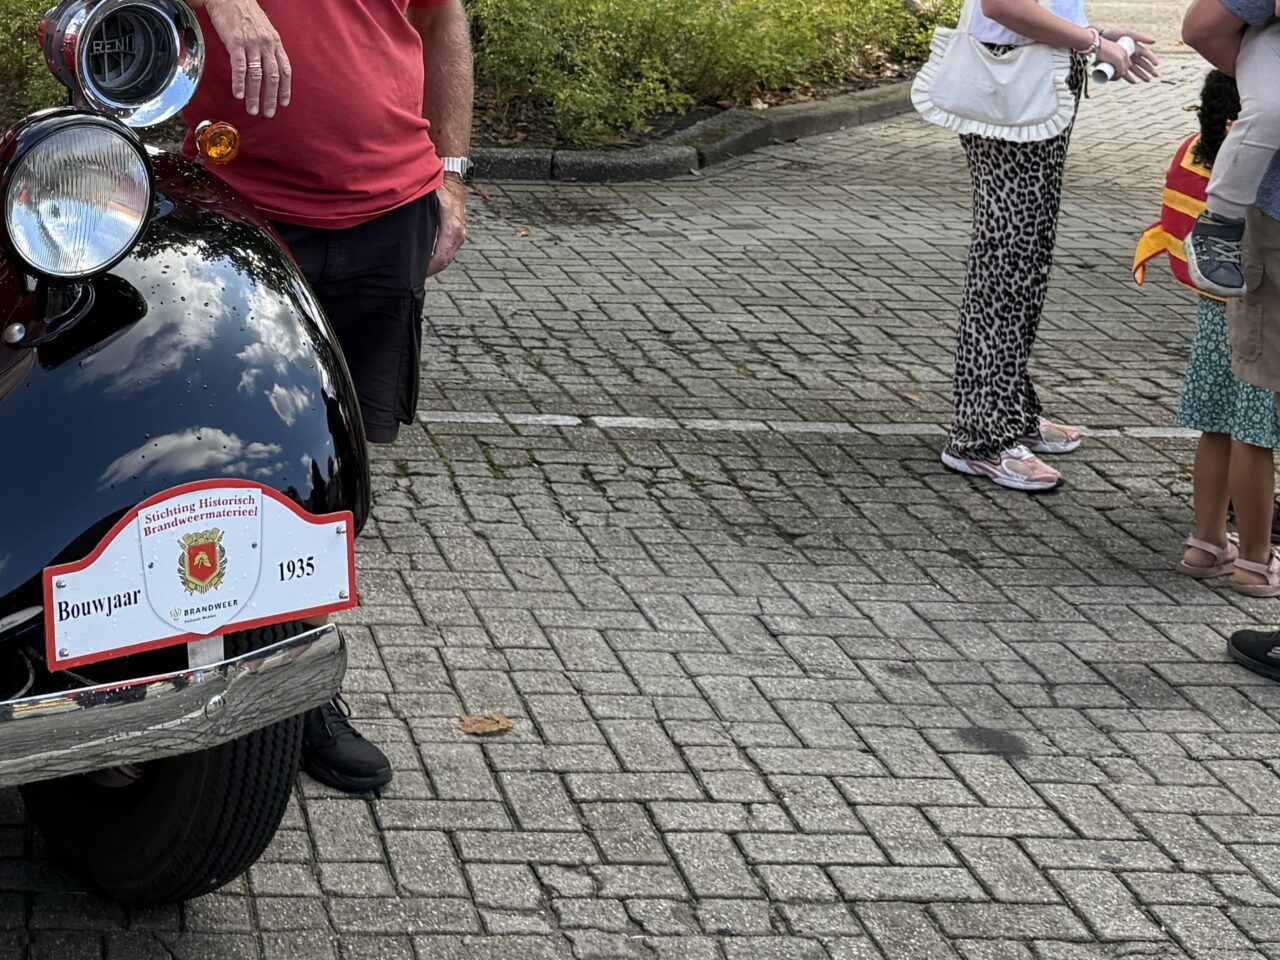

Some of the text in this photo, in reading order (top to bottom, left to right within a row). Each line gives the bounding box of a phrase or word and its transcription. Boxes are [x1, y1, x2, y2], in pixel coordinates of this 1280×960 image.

[143, 506, 258, 537] Brandweermaterieel
[145, 495, 255, 525] Stichting Historisch
[278, 556, 315, 581] 1935
[57, 589, 141, 622] Bouwjaar
[183, 599, 238, 617] BRANDWEER
